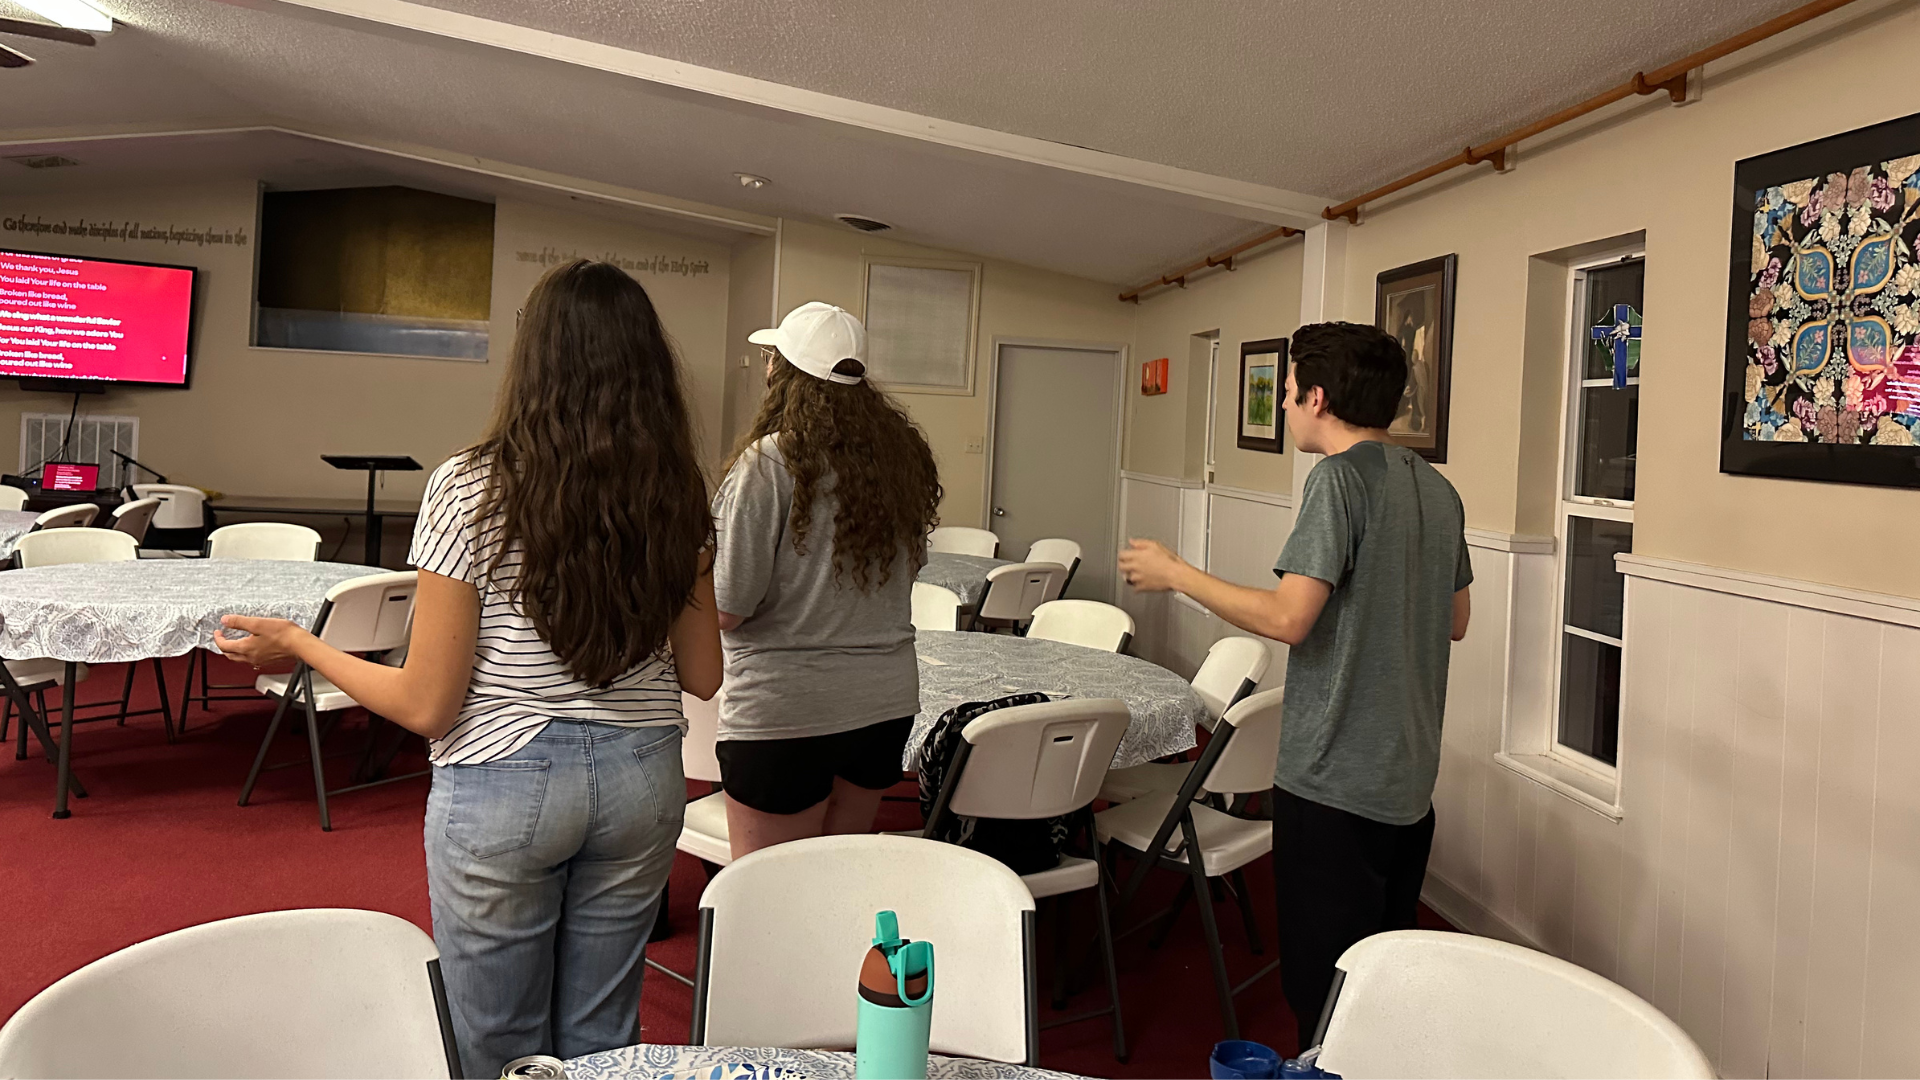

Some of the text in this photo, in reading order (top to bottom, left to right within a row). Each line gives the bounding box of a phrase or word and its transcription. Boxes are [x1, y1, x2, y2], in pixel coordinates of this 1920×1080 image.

[2, 218, 17, 231] Go
[18, 214, 51, 237] therefore
[52, 220, 67, 234] and
[68, 219, 87, 237] make
[88, 221, 118, 242] disciples
[120, 222, 129, 242] of
[128, 222, 140, 239] all
[205, 227, 223, 245] them
[224, 230, 233, 244] in
[234, 228, 247, 246] the
[16, 264, 38, 272] thank
[38, 266, 55, 274] you,
[56, 267, 78, 276] Jesus
[650, 256, 658, 275] of
[658, 256, 670, 274] the
[670, 256, 688, 276] Holy
[690, 260, 709, 278] Spirit
[30, 278, 48, 286] Your
[48, 279, 61, 287] life
[73, 282, 86, 290] the
[86, 283, 108, 291] table
[28, 290, 42, 298] like
[42, 292, 68, 301] bread,
[42, 300, 56, 308] like
[12, 311, 30, 321] sing
[55, 327, 72, 335] how
[86, 330, 109, 338] adore
[109, 330, 124, 338] You
[10, 337, 26, 345] You
[26, 338, 40, 346] laid
[40, 338, 58, 347] Your
[58, 340, 71, 348] life
[82, 342, 96, 350] the
[96, 343, 116, 351] table
